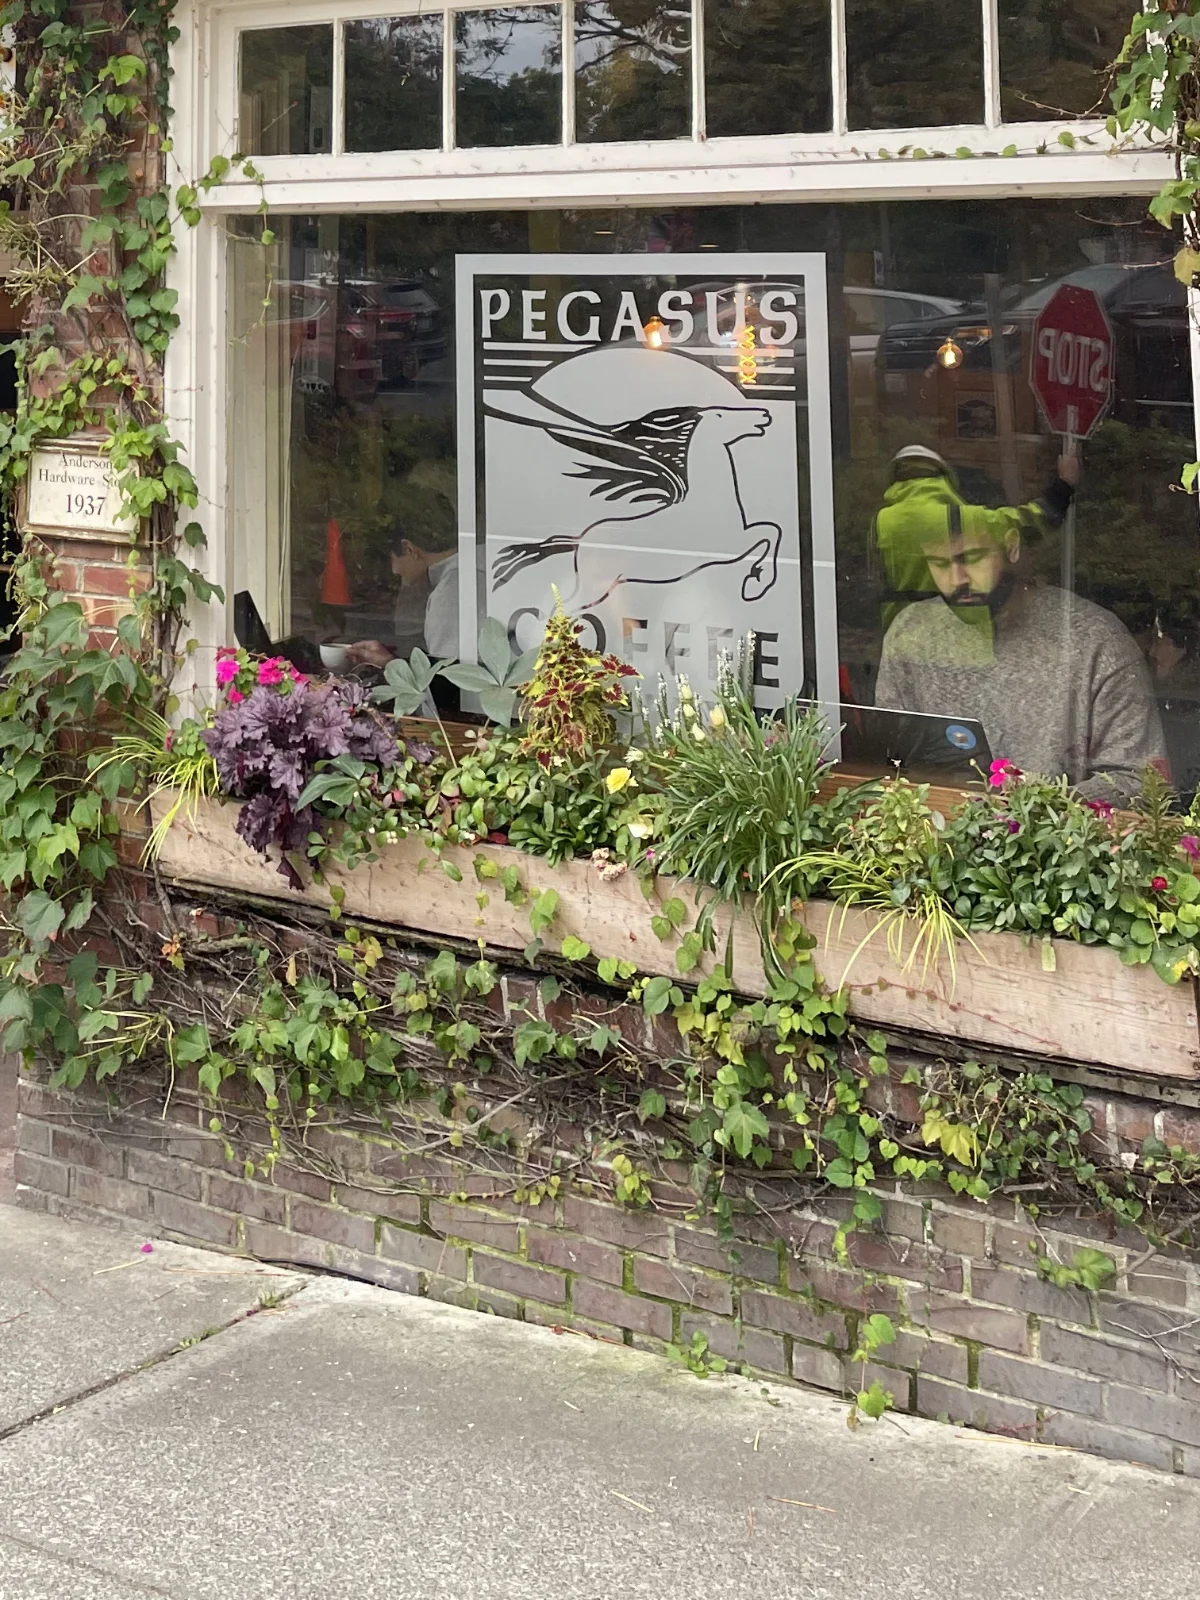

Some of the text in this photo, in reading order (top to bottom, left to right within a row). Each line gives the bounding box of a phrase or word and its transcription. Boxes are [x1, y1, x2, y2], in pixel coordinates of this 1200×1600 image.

[479, 289, 798, 345] PEGASUS
[59, 452, 113, 469] Anderson
[38, 468, 95, 486] Hardware
[66, 493, 107, 516] 1937
